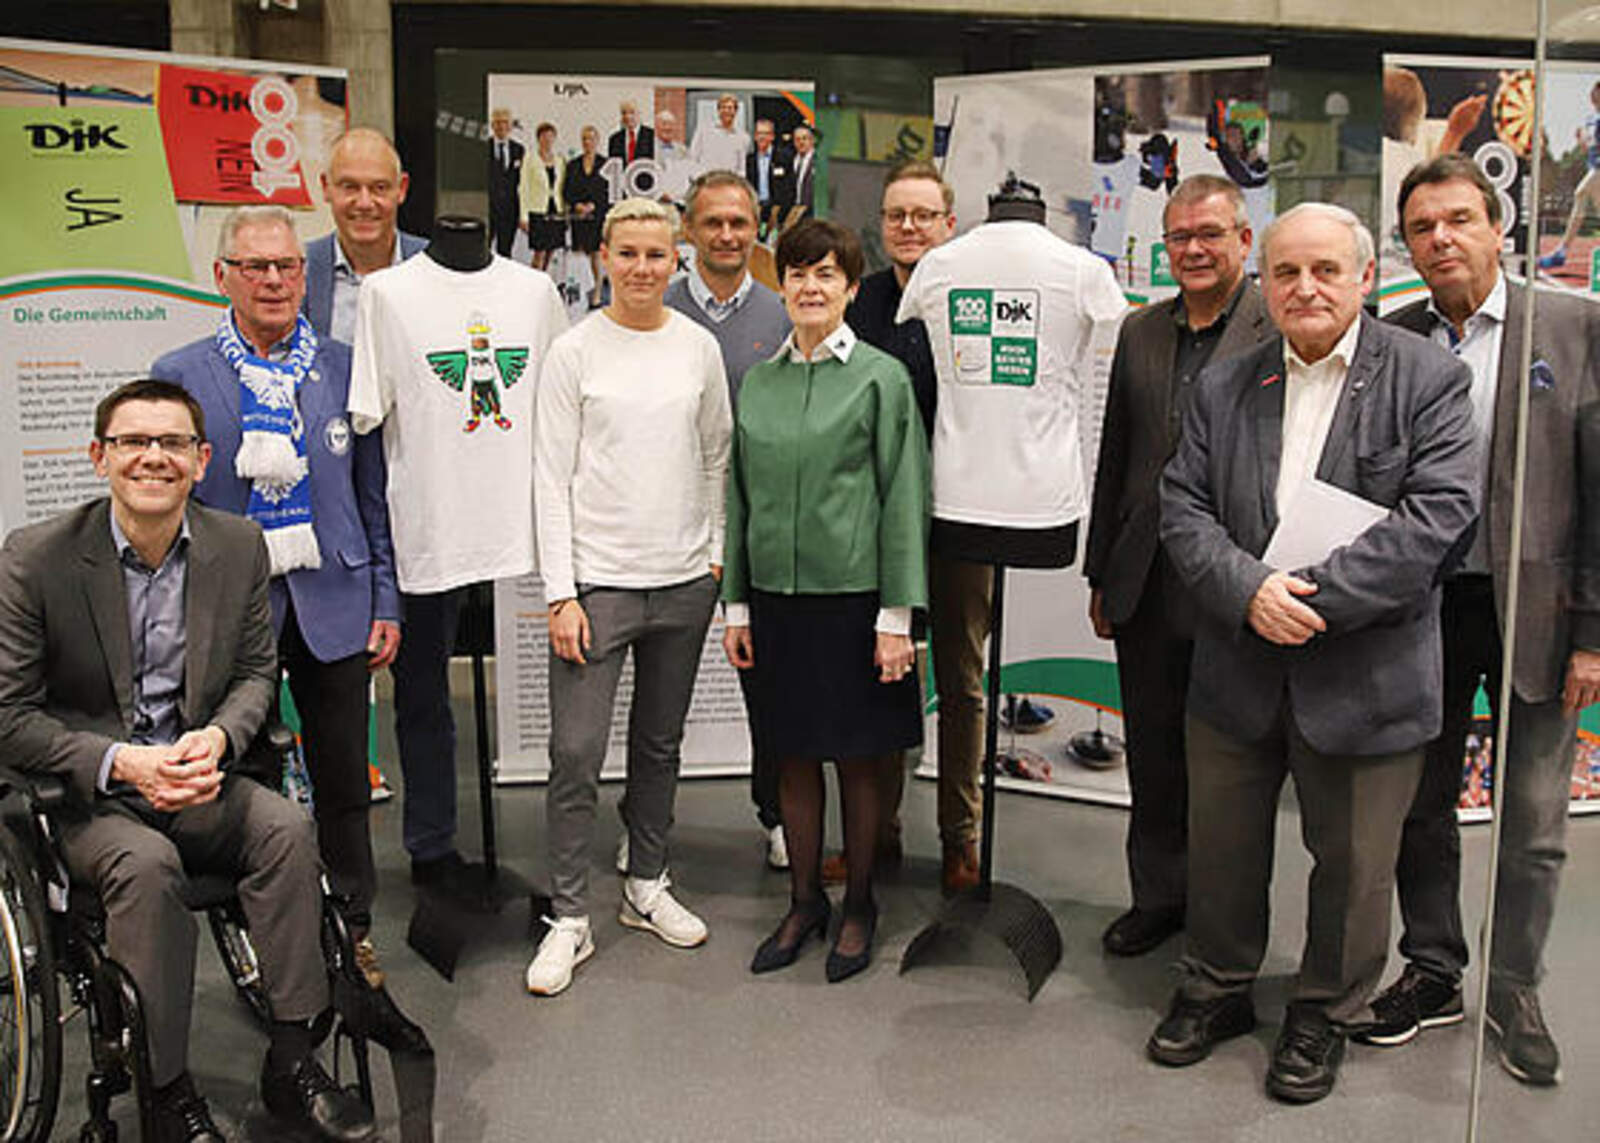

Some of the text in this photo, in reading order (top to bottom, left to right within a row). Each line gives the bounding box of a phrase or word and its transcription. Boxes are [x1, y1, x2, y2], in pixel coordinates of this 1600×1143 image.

[65, 189, 123, 231] JA
[13, 305, 167, 323] Die Gemeinschaft
